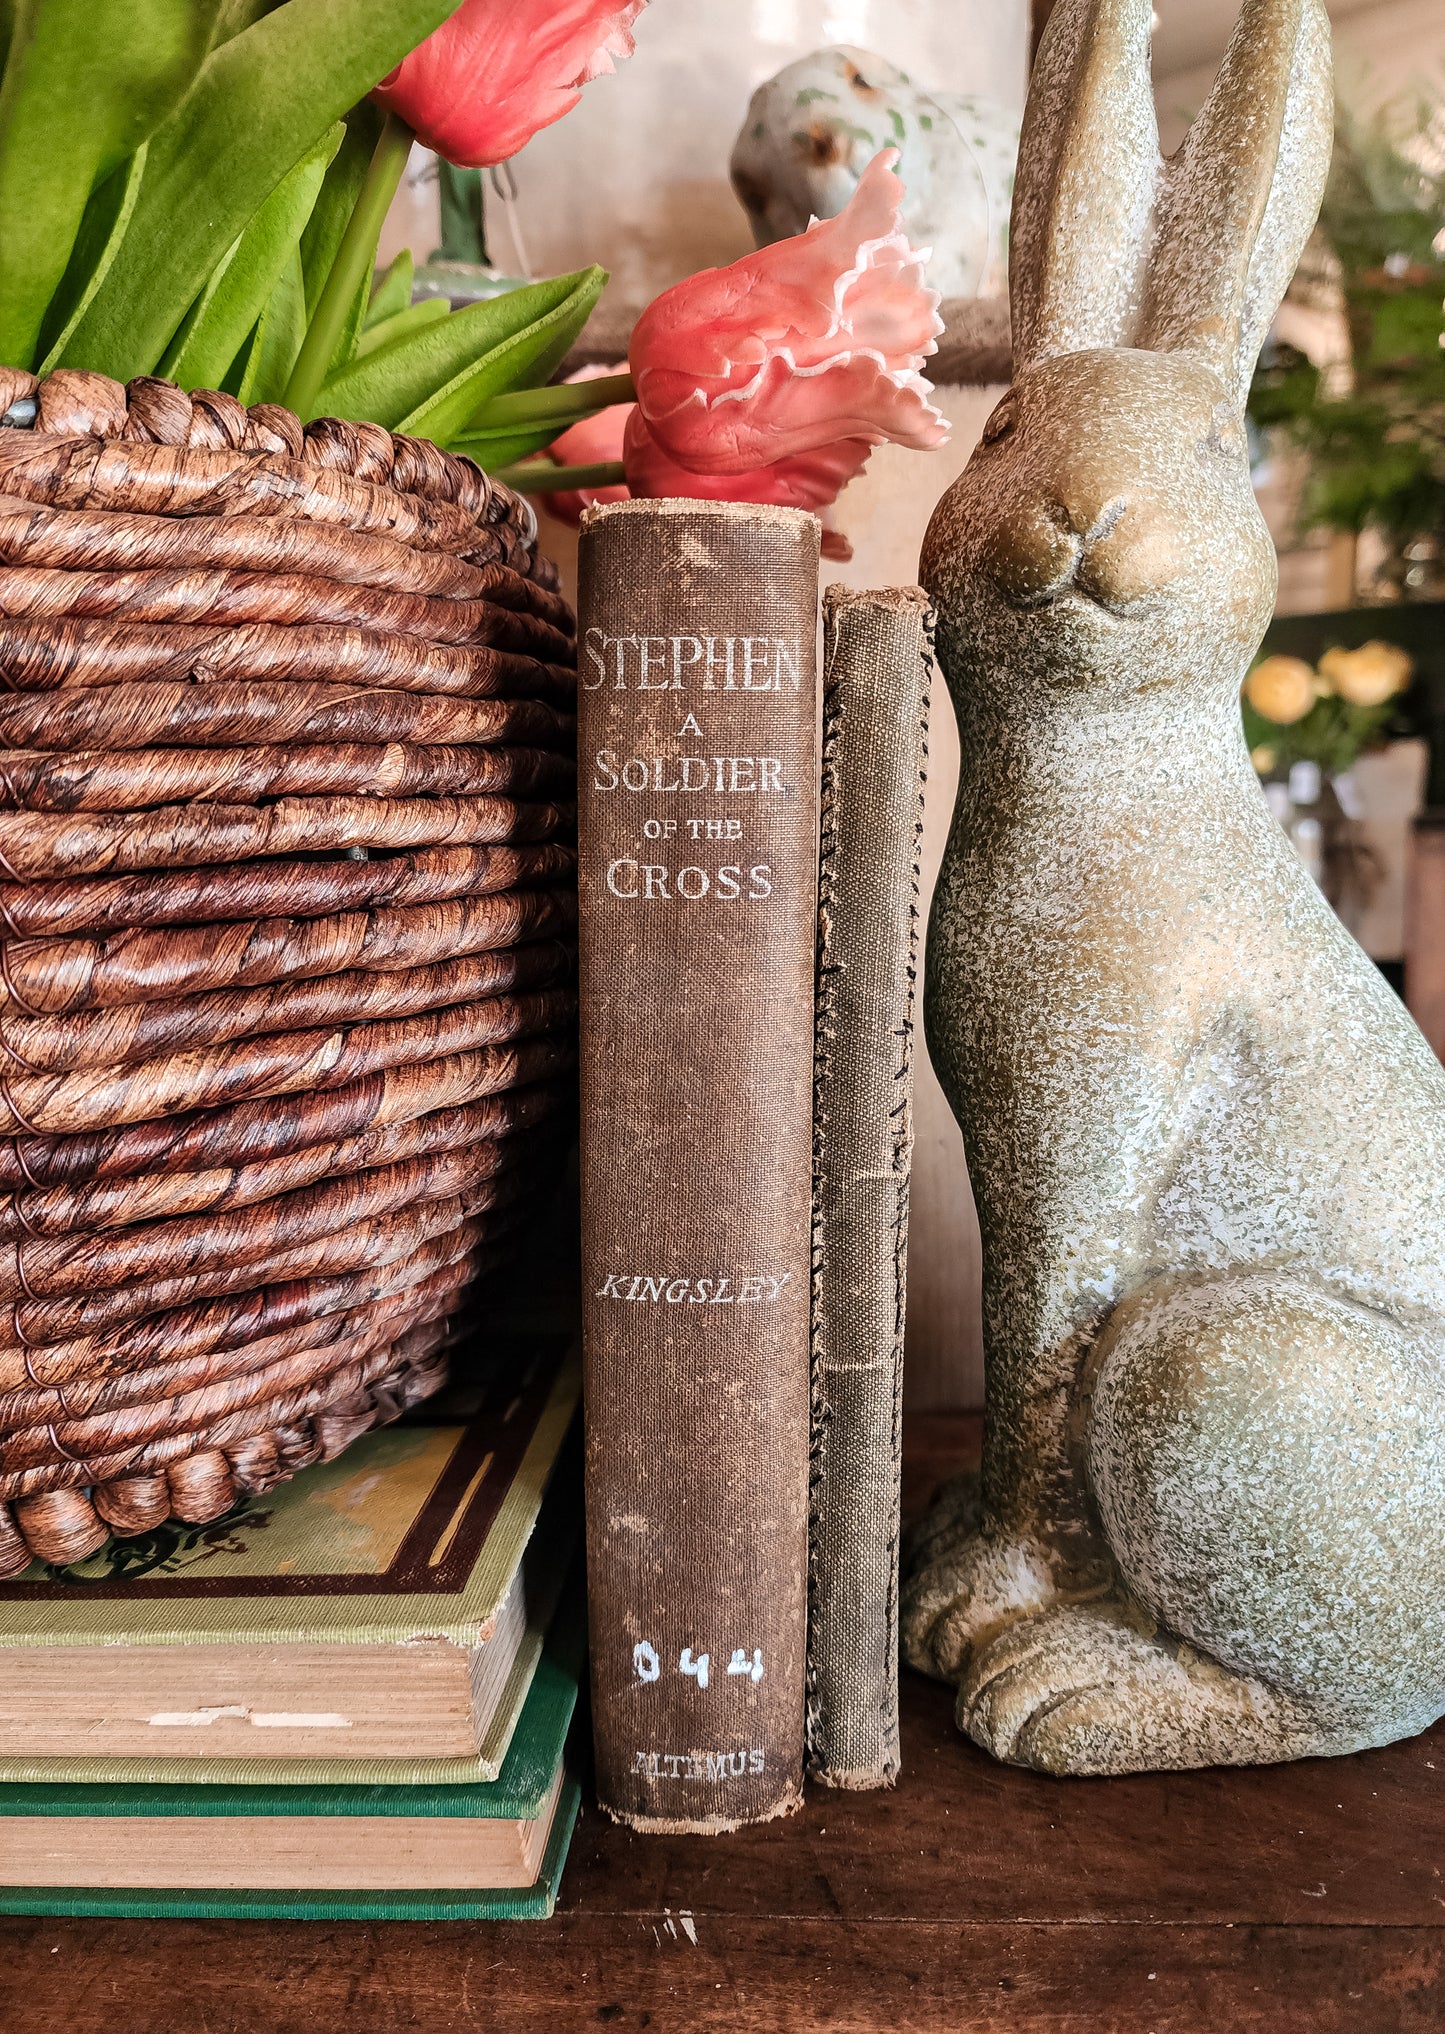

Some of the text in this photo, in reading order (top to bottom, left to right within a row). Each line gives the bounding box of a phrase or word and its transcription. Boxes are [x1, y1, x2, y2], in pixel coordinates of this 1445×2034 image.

[582, 627, 800, 691] STEPHEN
[677, 713, 703, 736] A
[594, 750, 785, 792] SOLDIER
[643, 819, 743, 840] OF THE
[606, 859, 772, 899] CROSS
[596, 1272, 791, 1303] KINGSLEY
